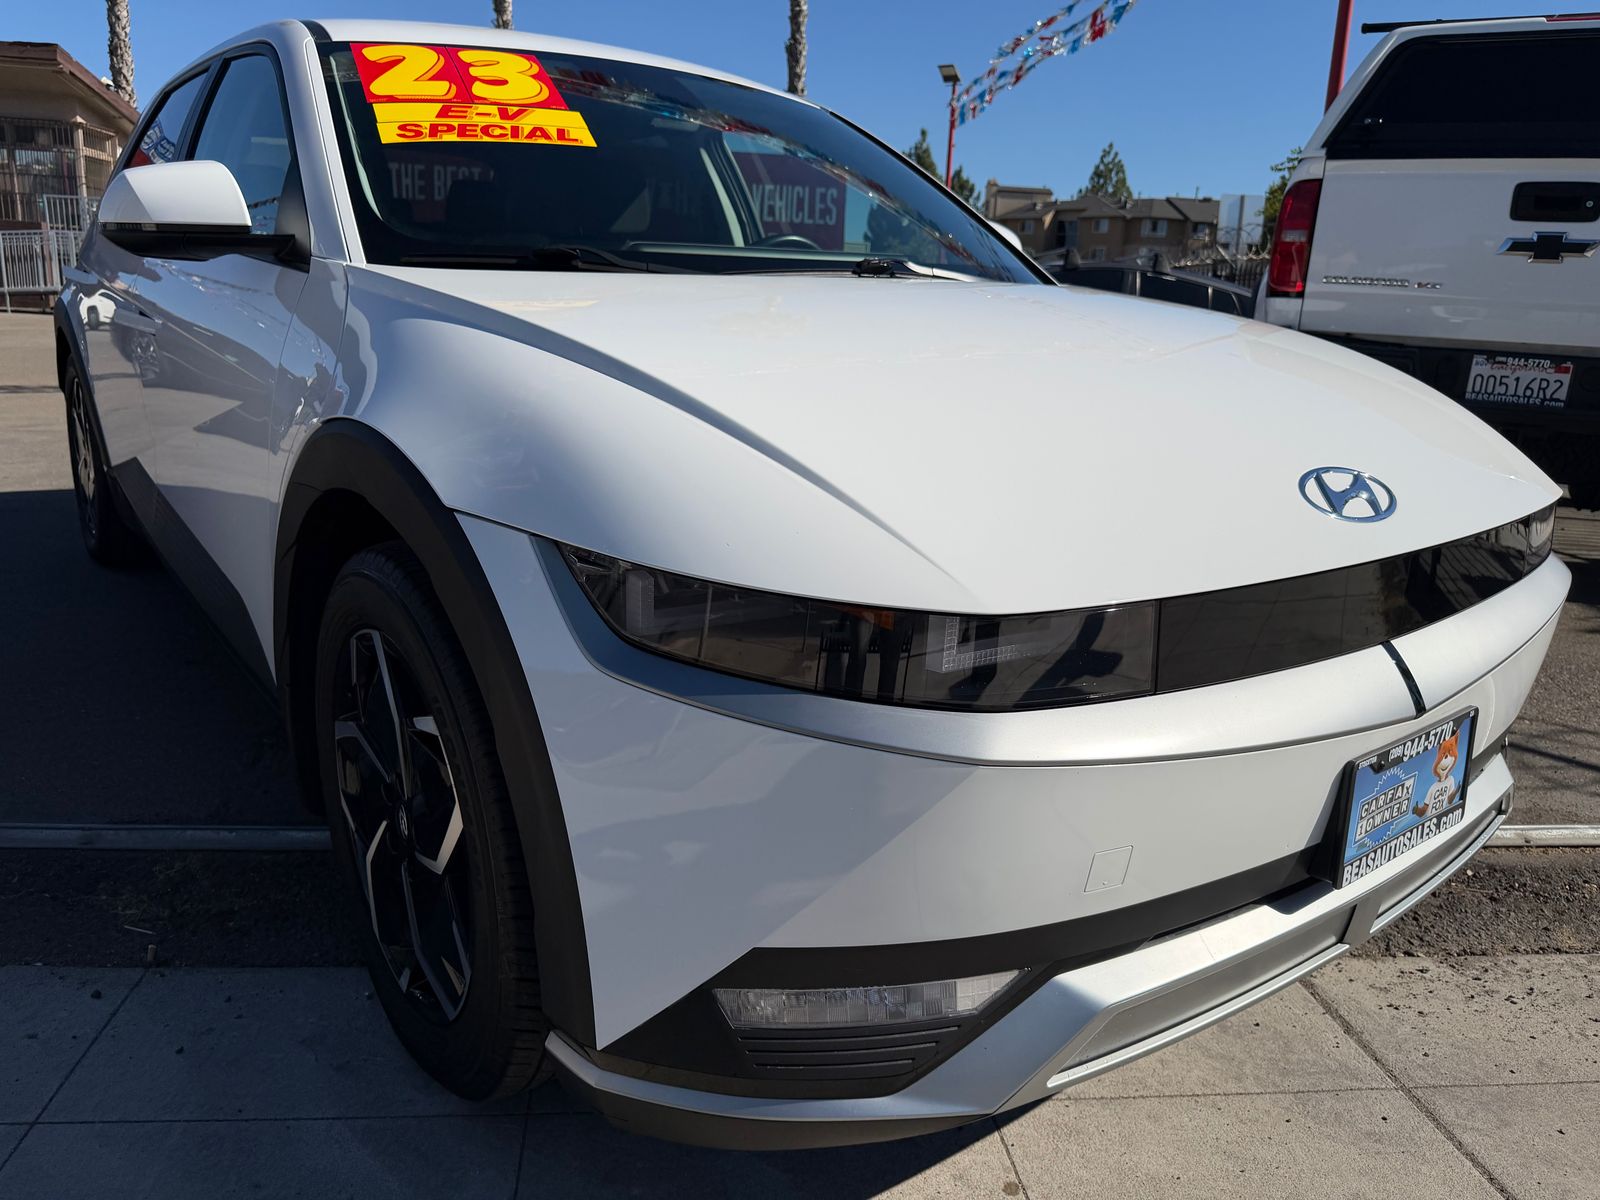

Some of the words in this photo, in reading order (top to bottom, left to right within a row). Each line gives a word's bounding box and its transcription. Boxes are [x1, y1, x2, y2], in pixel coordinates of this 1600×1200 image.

[361, 45, 550, 104] 23
[435, 104, 535, 122] E-V
[396, 123, 584, 144] SPECIAL
[388, 162, 426, 200] THE
[752, 184, 837, 225] VEHICLES
[1507, 357, 1551, 368] 944-5770
[1471, 373, 1564, 400] 00516R2
[1388, 746, 1404, 763] (209)
[1403, 721, 1454, 763] 944-5770
[1361, 783, 1412, 818] CARFAX
[1430, 796, 1447, 815] FOX
[1433, 785, 1448, 801] CAR
[1342, 808, 1463, 888] BEASAUTOSALES.com
